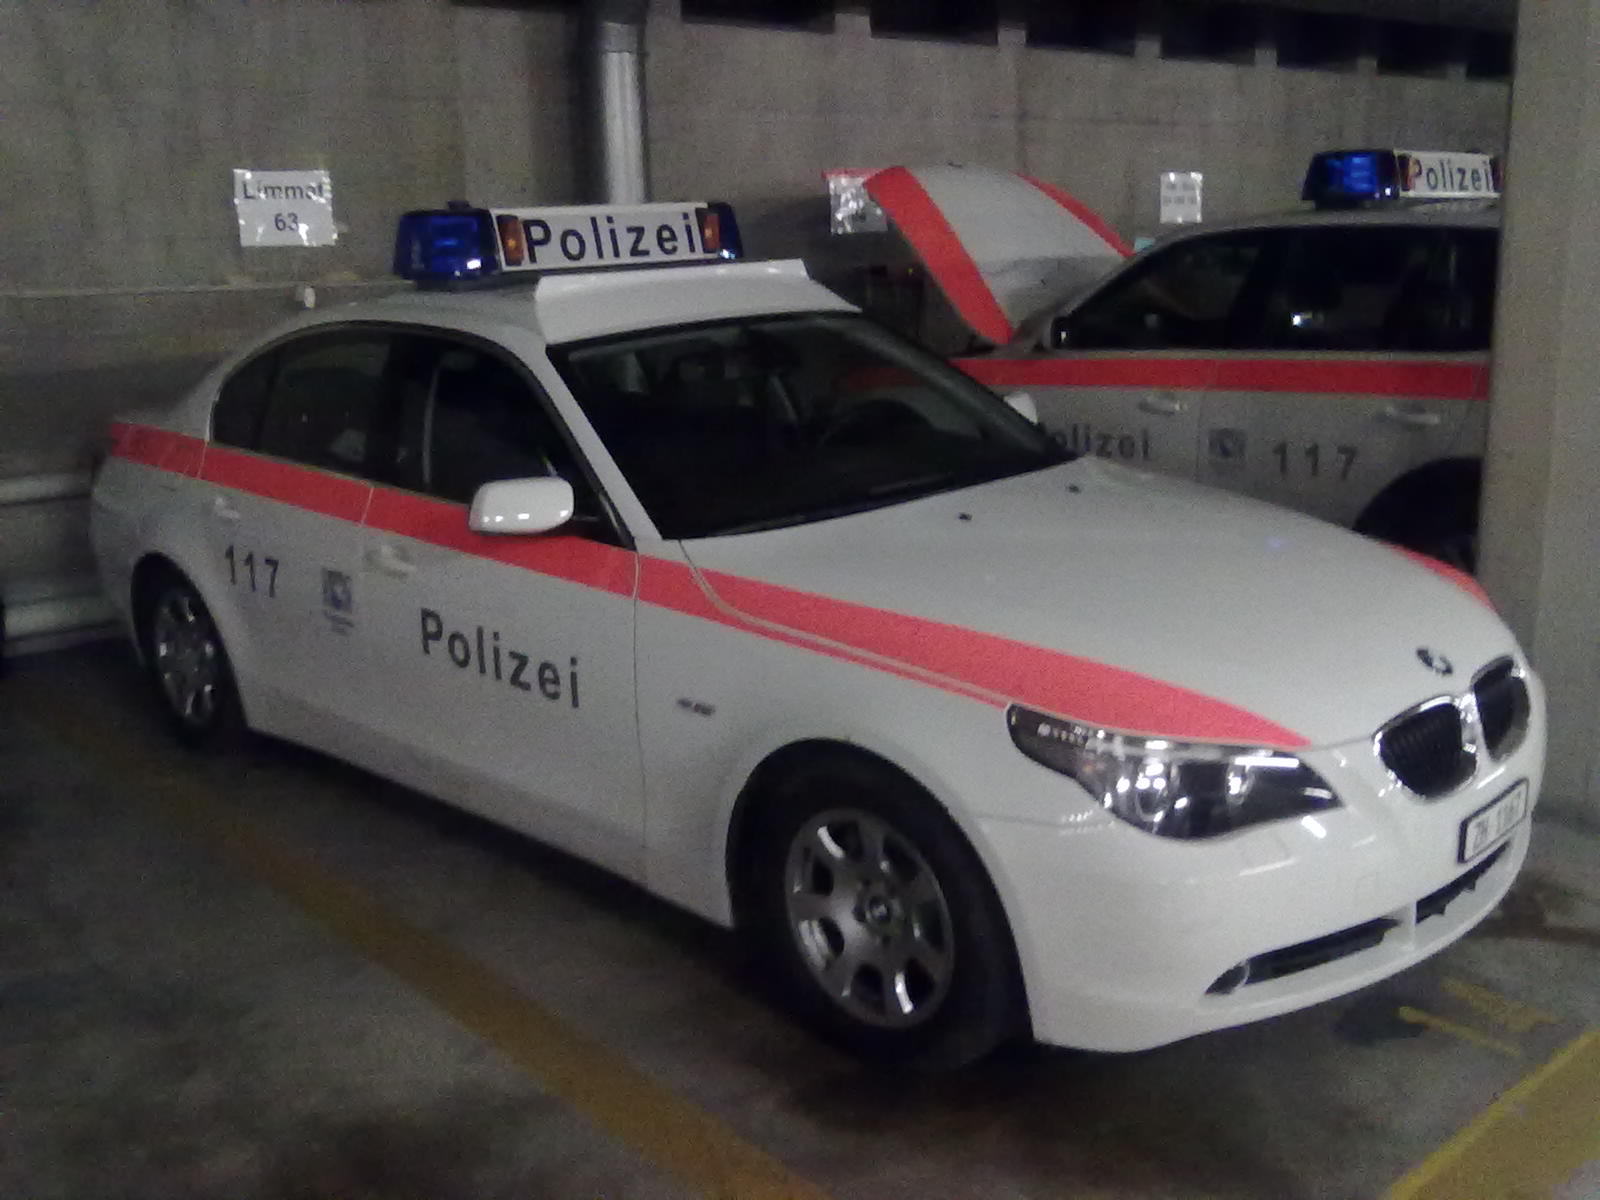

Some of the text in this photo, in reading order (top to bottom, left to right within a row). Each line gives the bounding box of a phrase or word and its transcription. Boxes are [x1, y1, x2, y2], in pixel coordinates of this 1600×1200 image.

[1407, 157, 1491, 191] Polizei
[274, 213, 299, 231] 63
[523, 212, 696, 264] Polizei
[1041, 423, 1150, 461] olizei
[1272, 441, 1359, 481] 117
[225, 545, 279, 598] 117
[420, 607, 579, 708] Polizei
